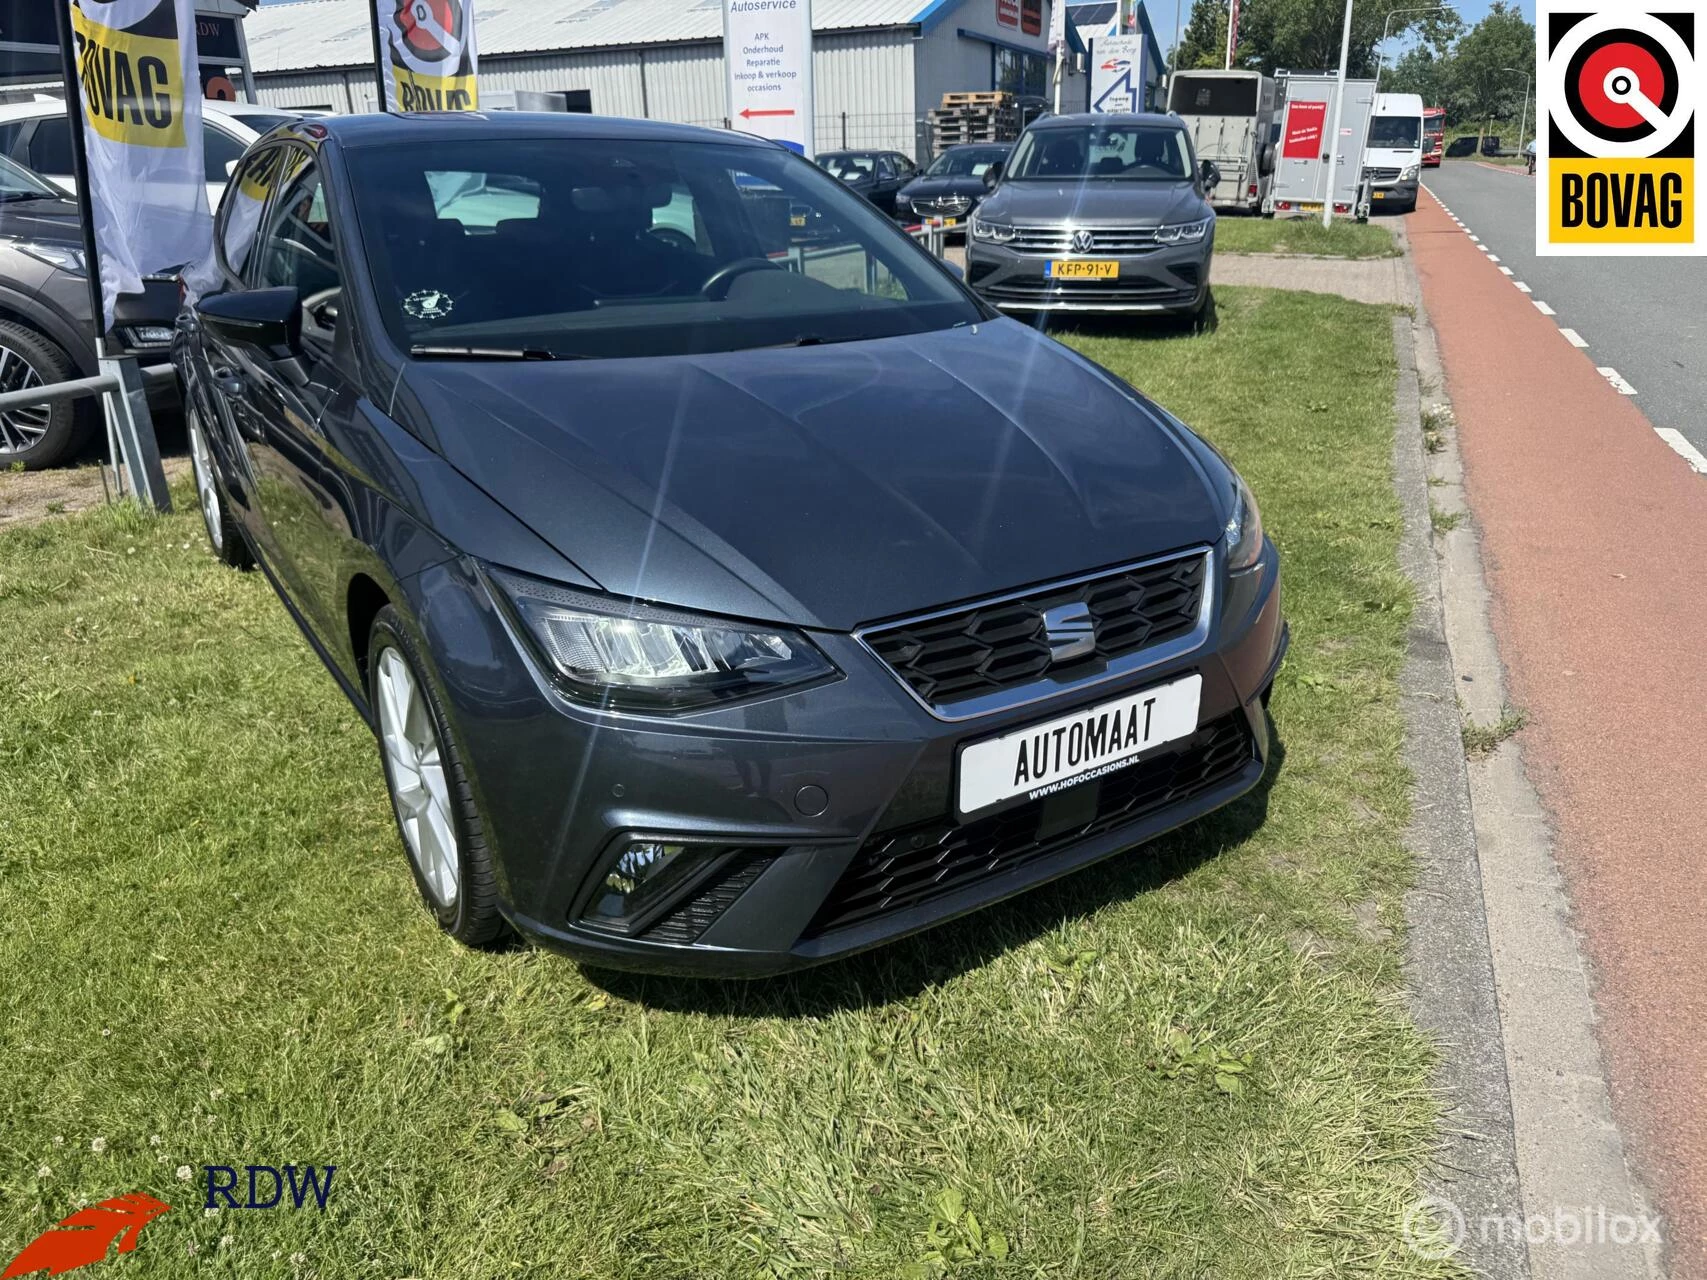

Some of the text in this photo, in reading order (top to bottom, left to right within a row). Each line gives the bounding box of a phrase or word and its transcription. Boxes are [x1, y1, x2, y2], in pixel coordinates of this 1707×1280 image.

[730, 0, 797, 14] Autoservice
[197, 22, 220, 37] DW
[754, 32, 769, 41] APK
[742, 44, 784, 55] Onderhoud
[746, 58, 781, 67] Reparatie
[758, 71, 764, 79] &
[766, 70, 797, 79] verkoop
[747, 83, 782, 92] occasions
[1057, 264, 1112, 276] KFP-91-V
[1013, 697, 1156, 787] AUTOMAAT
[1028, 754, 1140, 800] WWW.HOFOCCASIONS.NL
